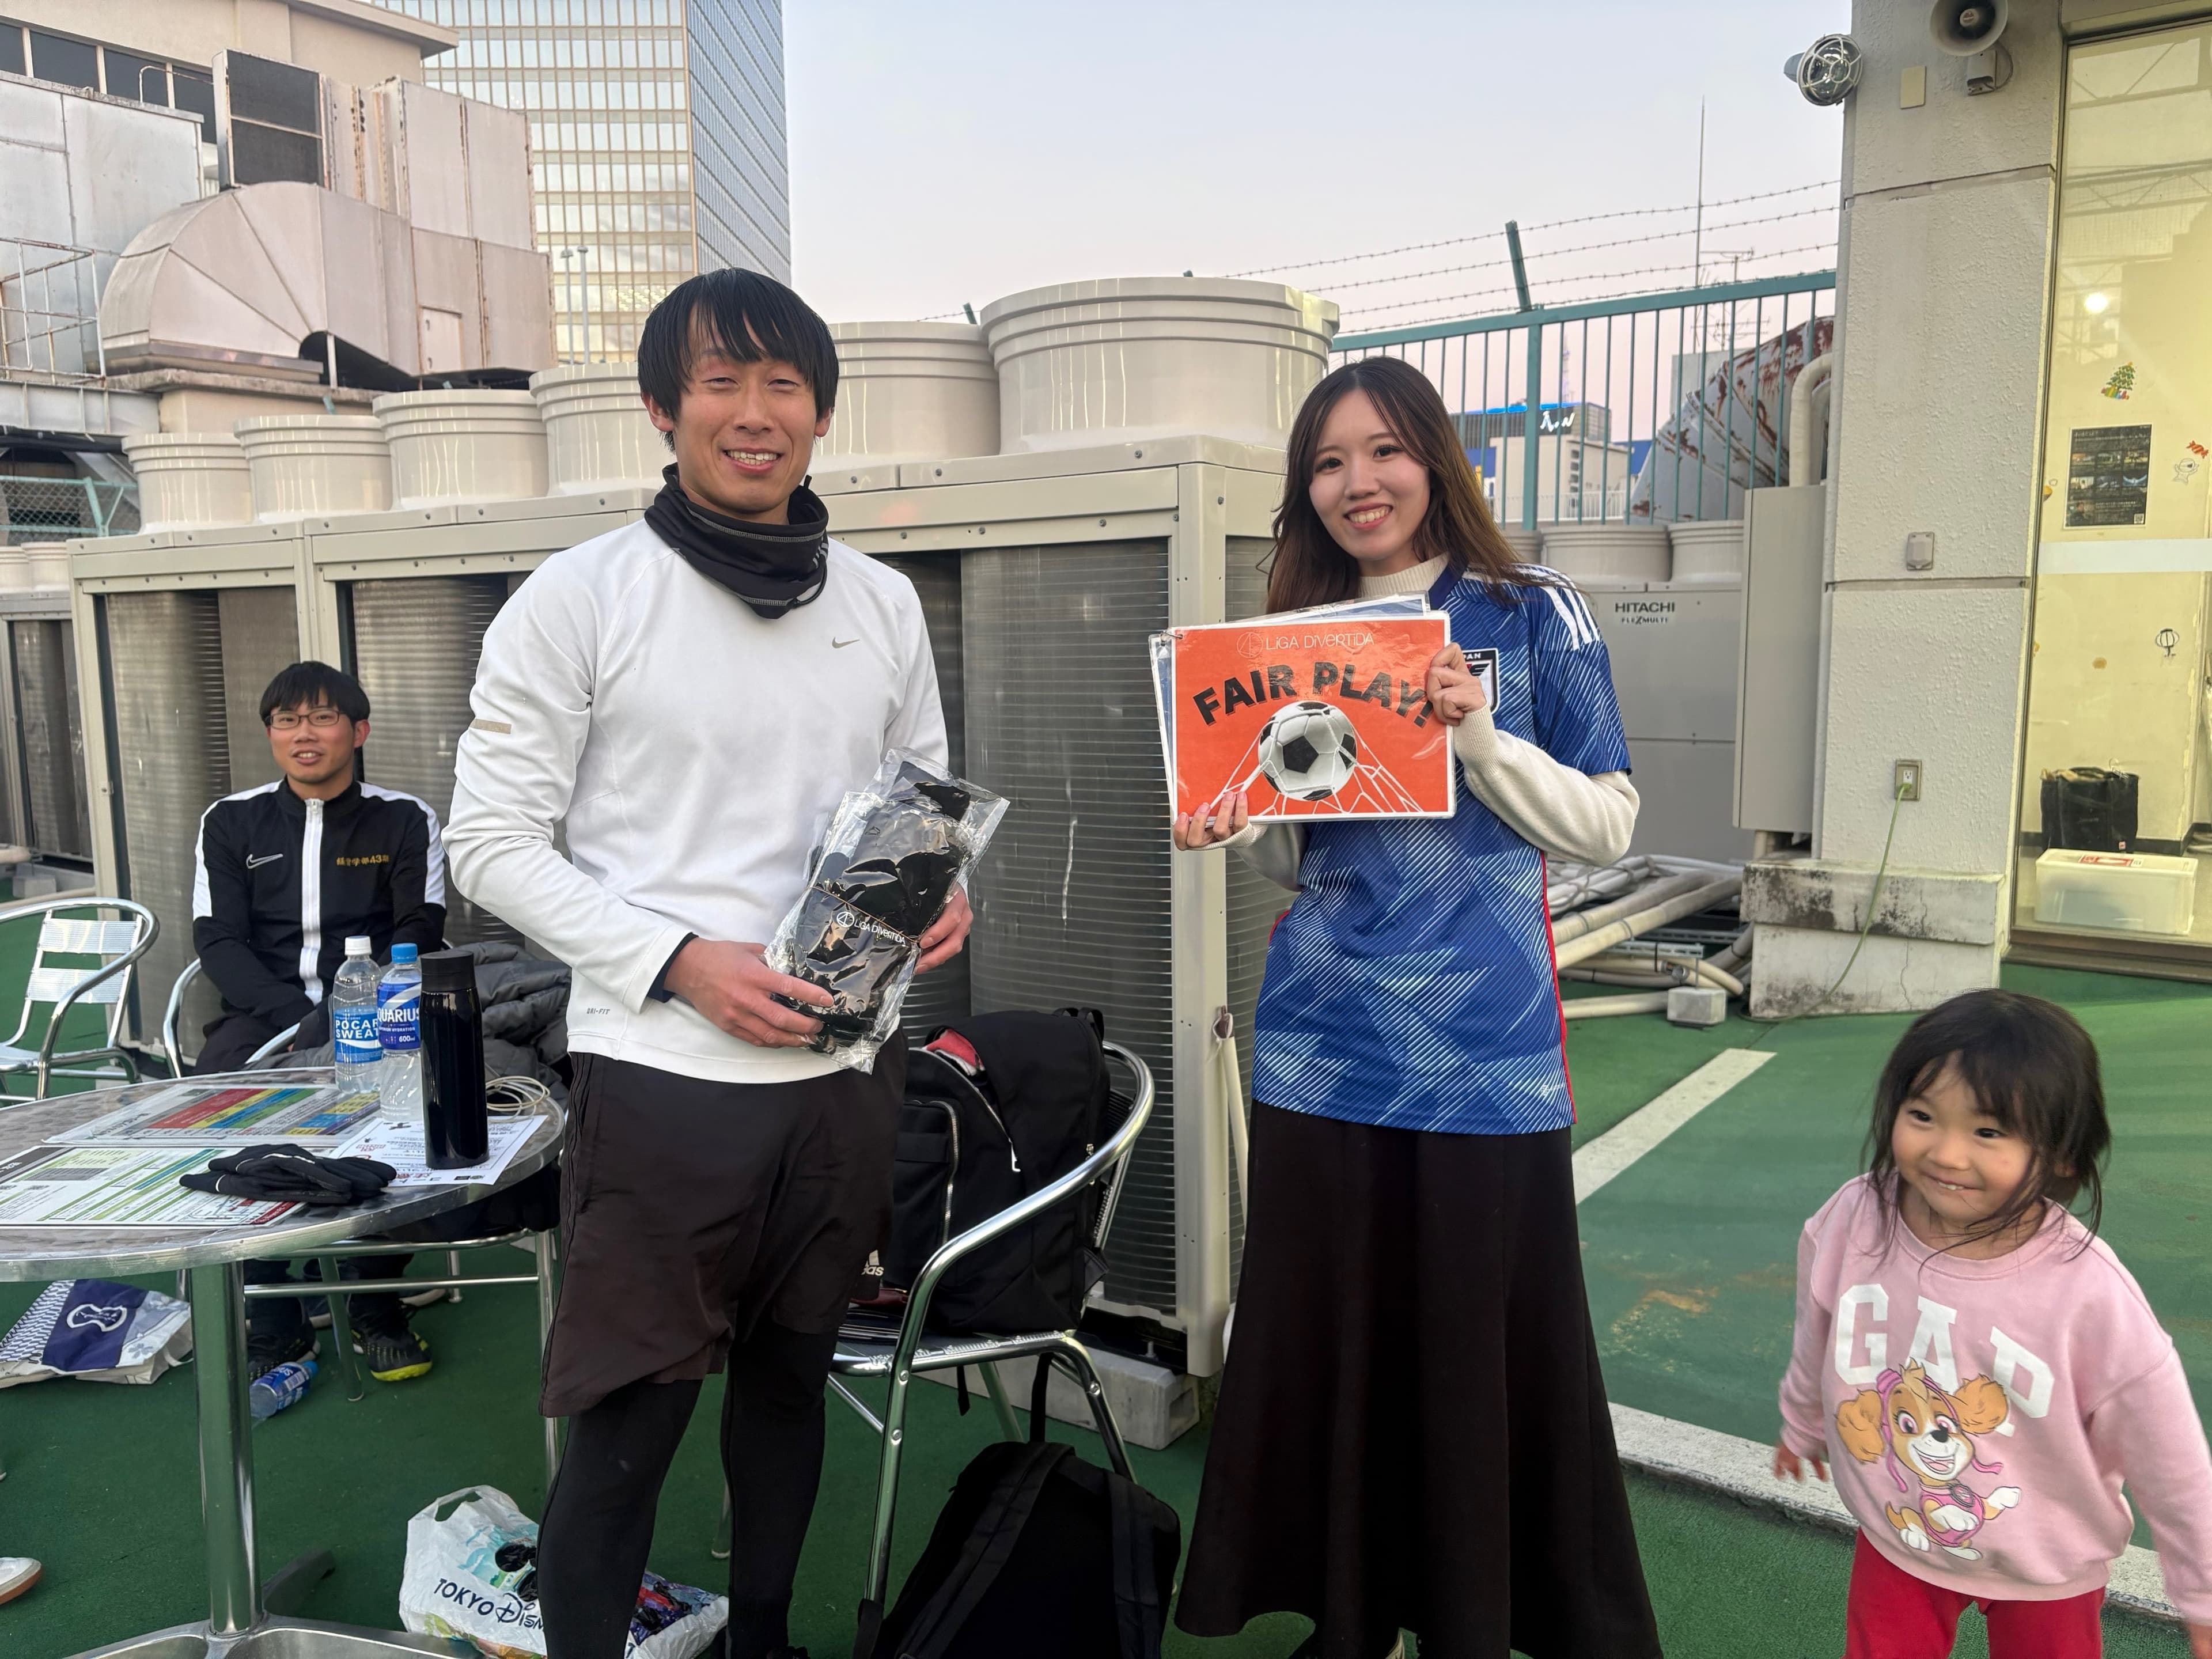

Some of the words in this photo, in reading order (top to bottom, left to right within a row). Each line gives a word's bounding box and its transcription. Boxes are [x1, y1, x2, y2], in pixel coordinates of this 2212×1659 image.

[1615, 602, 1675, 612] HITACHI
[1193, 664, 1297, 726] FAIR
[1834, 1283, 2055, 1438] GAP
[434, 1578, 494, 1616] TOKYO
